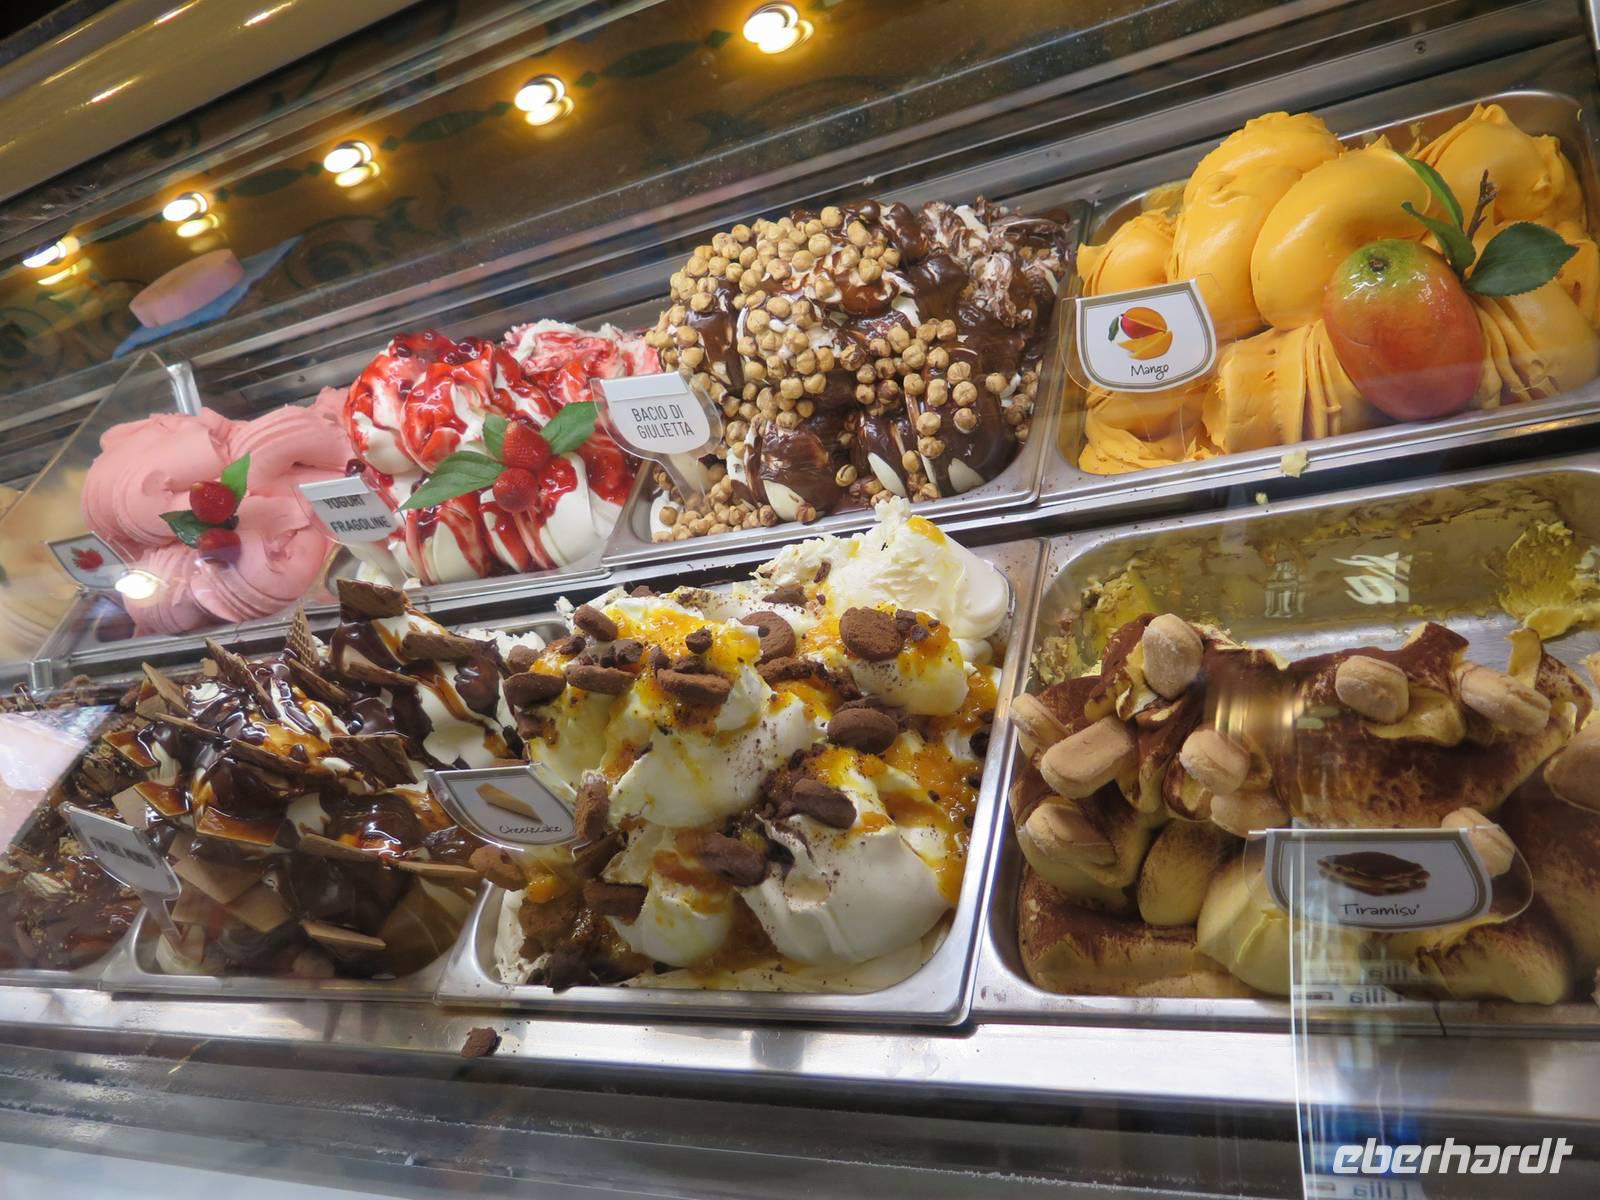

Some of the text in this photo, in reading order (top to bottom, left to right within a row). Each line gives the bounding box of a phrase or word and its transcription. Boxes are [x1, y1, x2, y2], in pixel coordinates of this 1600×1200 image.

[1131, 364, 1169, 380] Mango
[631, 404, 684, 422] BACIO DI
[636, 421, 695, 439] GIULIETTA
[330, 516, 392, 533] FRAGOLINE
